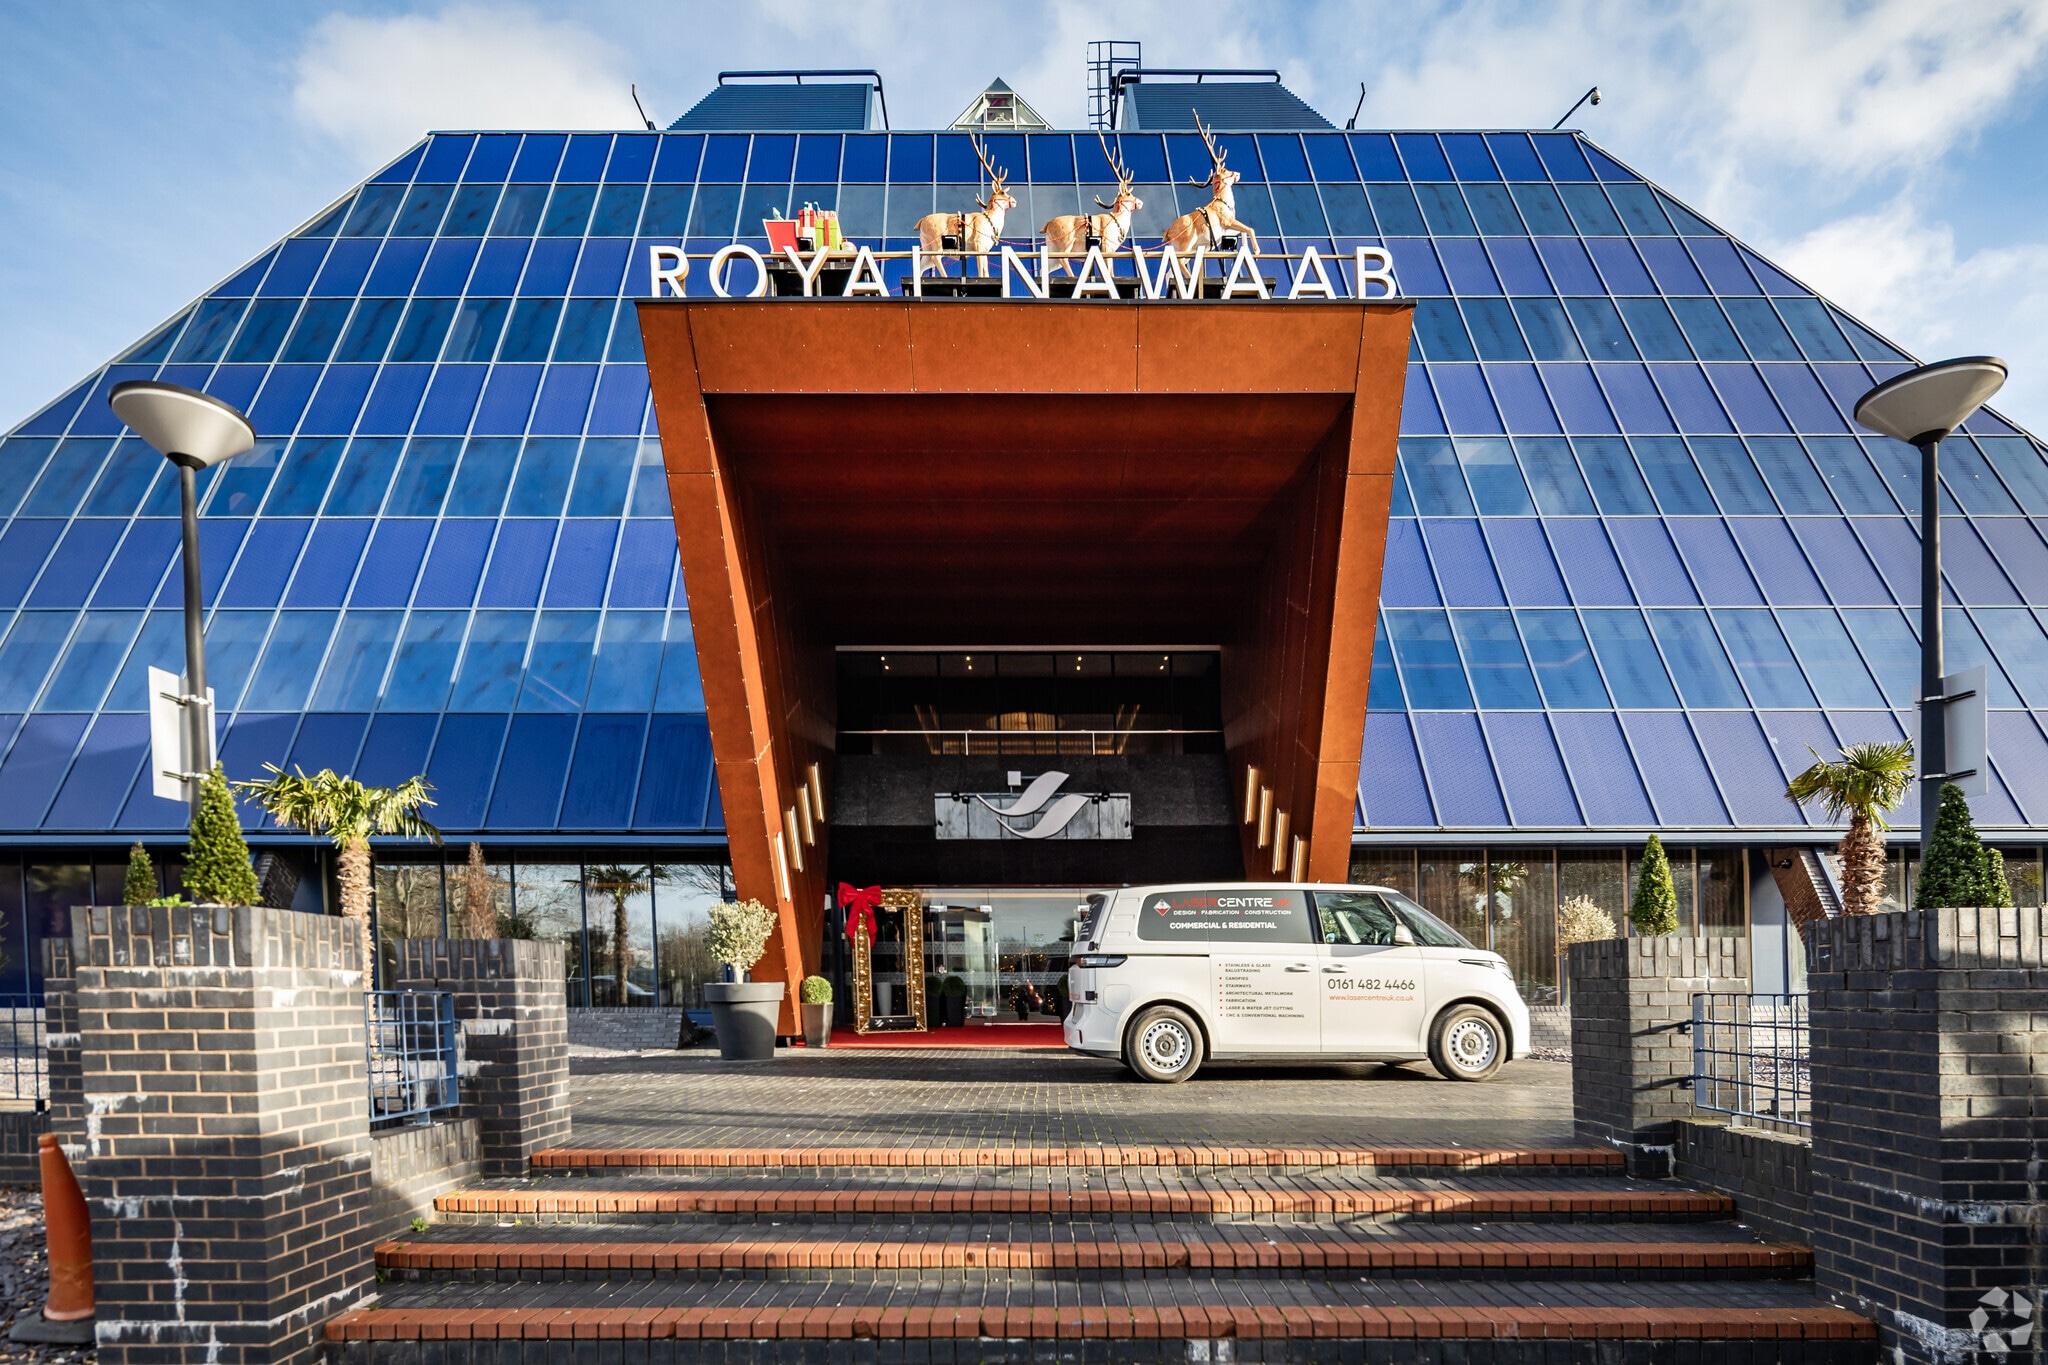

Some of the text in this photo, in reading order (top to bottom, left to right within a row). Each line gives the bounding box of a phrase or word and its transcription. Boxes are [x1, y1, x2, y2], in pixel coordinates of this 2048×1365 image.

[1001, 244, 1399, 299] NAWAAB
[1169, 922, 1221, 930] COMMERCIAL
[1327, 978, 1416, 990] 0161 482 4466
[1328, 994, 1415, 1002] www.lasercentreuk.co.uk
